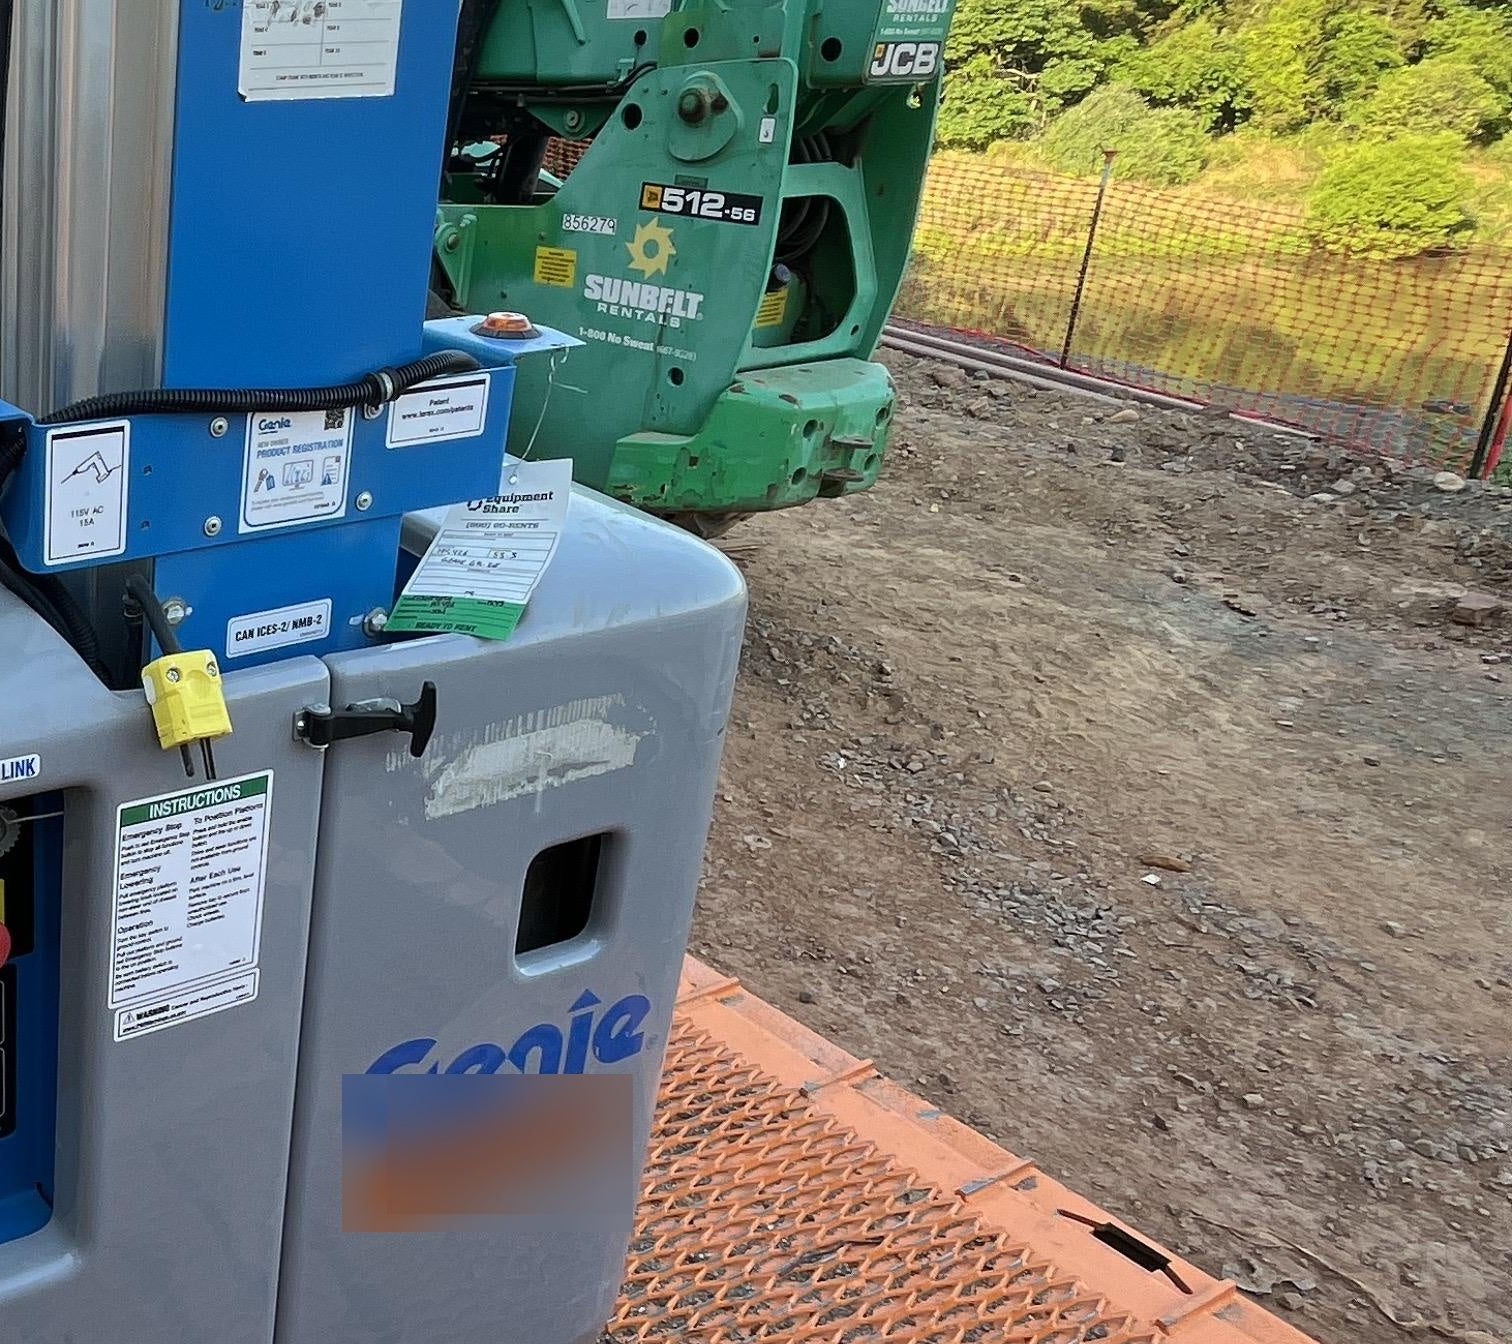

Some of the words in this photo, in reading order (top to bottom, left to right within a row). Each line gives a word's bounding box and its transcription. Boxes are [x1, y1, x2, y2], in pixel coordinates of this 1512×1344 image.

[892, 13, 938, 23] RENTALS
[870, 42, 939, 75] JCB
[564, 216, 616, 233] 856279
[583, 274, 704, 319] SUNBELT
[596, 302, 681, 328] RENTALS
[579, 326, 606, 341] 1-800
[607, 331, 622, 344] No
[623, 335, 655, 351] Sweat
[258, 417, 291, 430] Genie
[482, 504, 520, 514] Share
[235, 629, 255, 641] CAN
[1, 757, 36, 781] LINK
[149, 784, 241, 819] INSTRUCTIONS
[120, 865, 162, 880] Emergency
[117, 920, 154, 935] Operation
